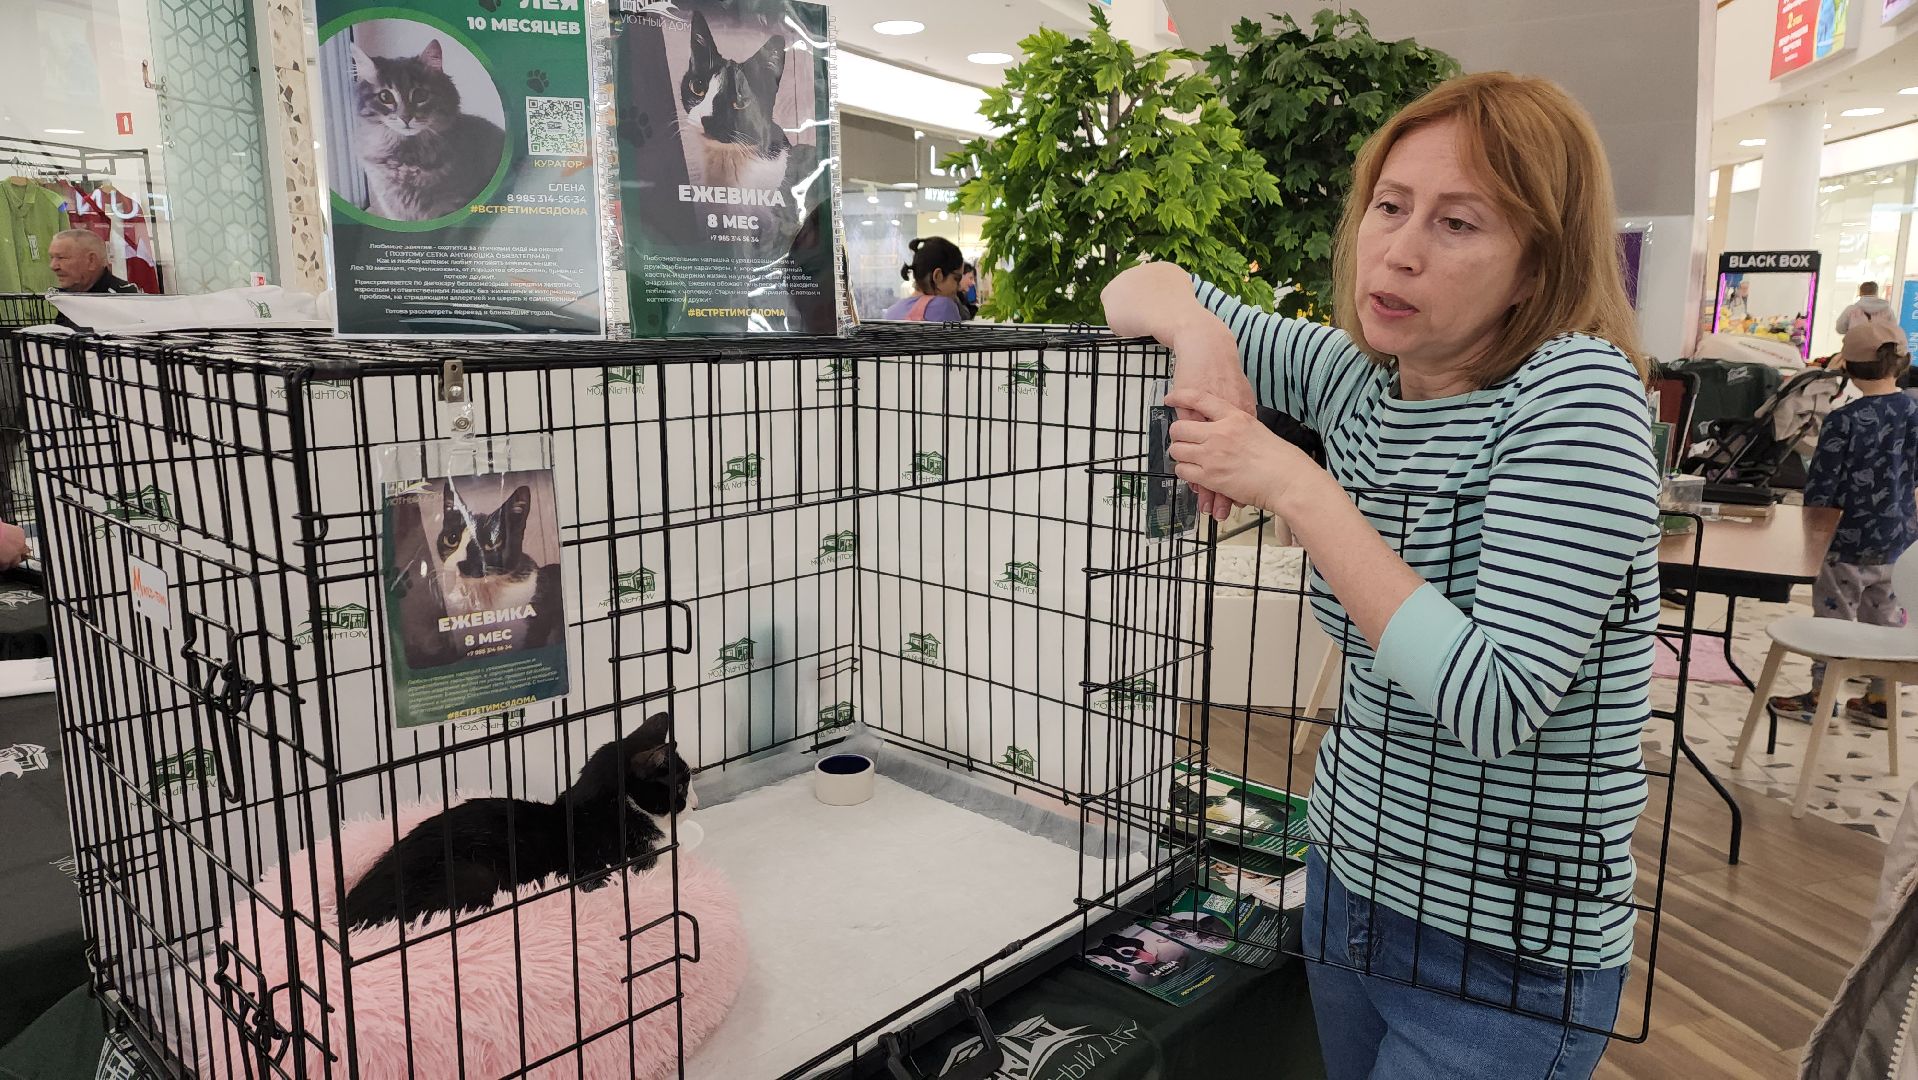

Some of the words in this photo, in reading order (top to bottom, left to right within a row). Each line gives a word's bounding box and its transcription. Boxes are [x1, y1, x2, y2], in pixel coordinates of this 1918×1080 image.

[466, 16, 487, 30] 10
[492, 18, 581, 36] МЕСЯЦЕВ
[620, 13, 666, 27] УЮТНЫЙ
[668, 20, 692, 32] ДОМ
[507, 194, 514, 202] 8
[517, 194, 536, 203] 985
[537, 195, 586, 204] 314-56-34
[679, 185, 786, 208] ЕЖЕВИКА
[470, 205, 588, 217] #ВСТРЕТИМСЯДОМА
[707, 214, 718, 228] 8
[723, 215, 760, 230] МЕС
[1729, 254, 1777, 268] BLACK
[1778, 254, 1811, 268] BOX
[438, 604, 537, 633] ЕЖЕВИКА
[464, 635, 475, 647] 8
[478, 629, 513, 645] МЕС
[447, 694, 537, 720] #ВСТРЕТИМСЯДОМА
